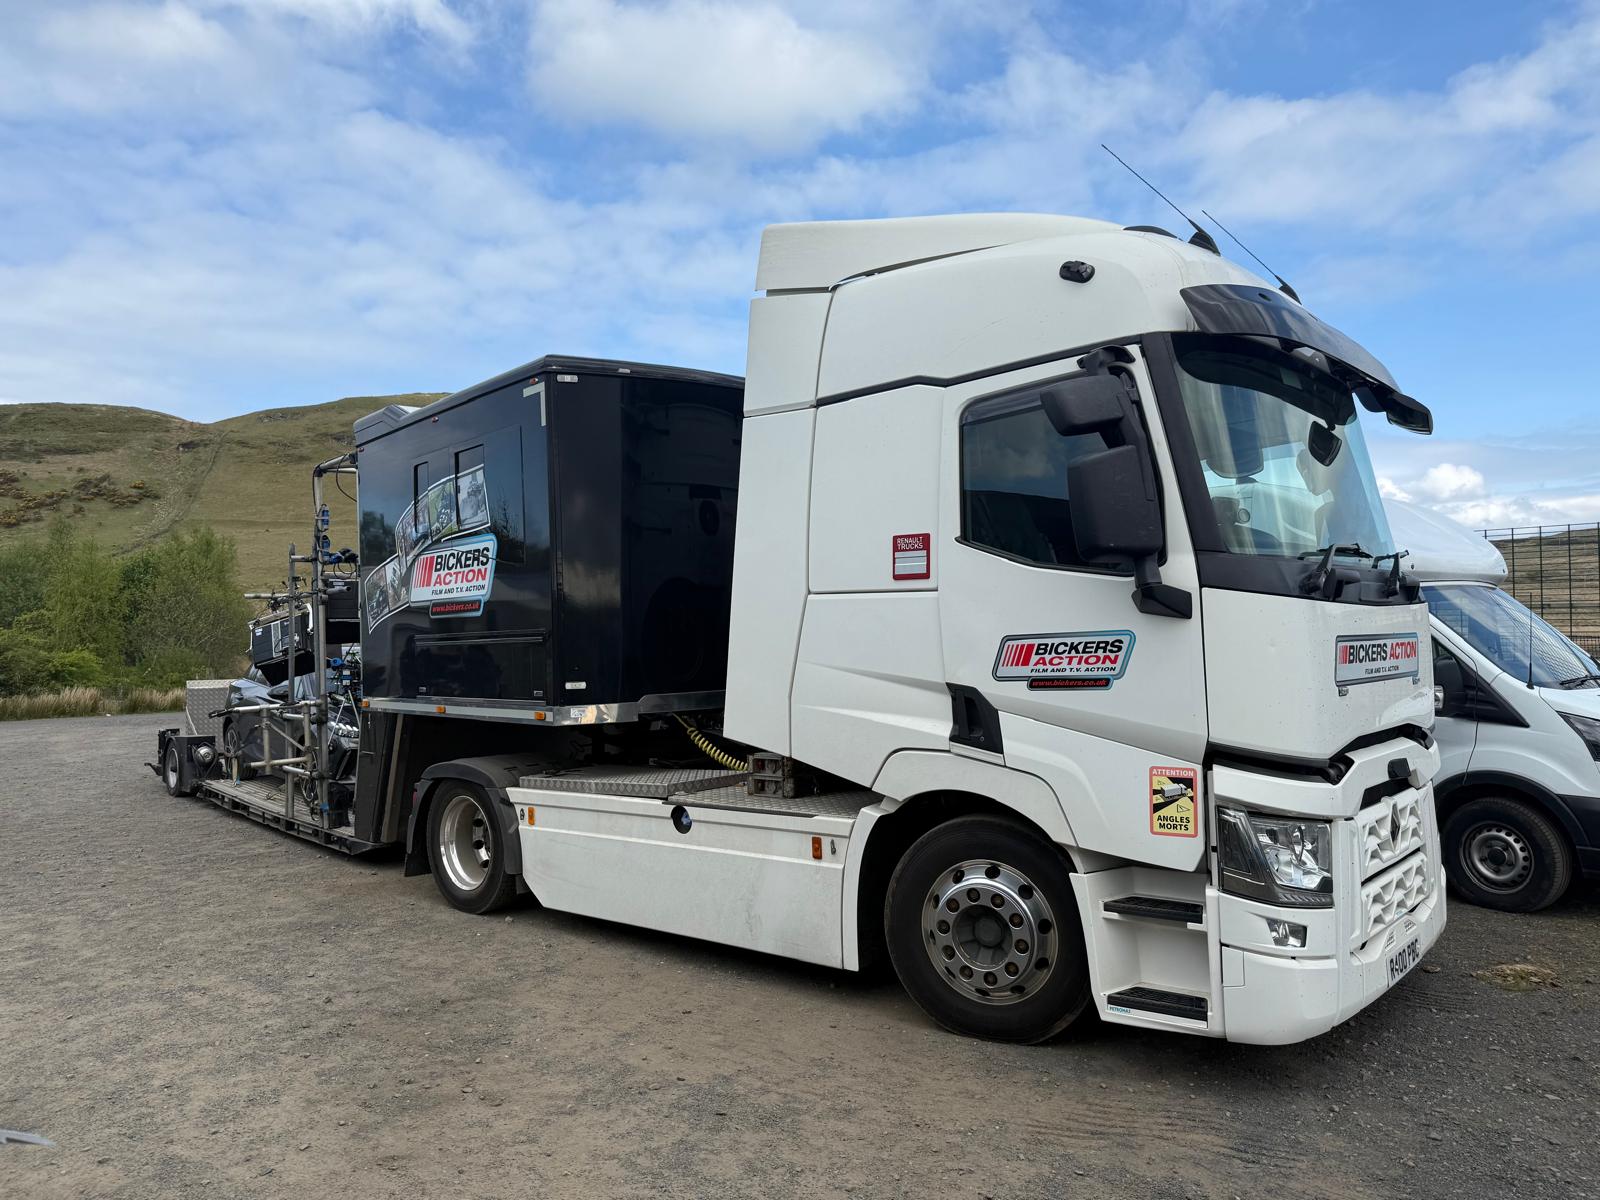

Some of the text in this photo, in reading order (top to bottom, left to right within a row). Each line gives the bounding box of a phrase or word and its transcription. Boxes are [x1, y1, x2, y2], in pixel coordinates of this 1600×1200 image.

[434, 547, 490, 572] BICKERS
[433, 568, 488, 587] ACTION
[465, 584, 486, 592] ACTION
[432, 602, 480, 612] www.bickers.co.uk
[1034, 639, 1124, 656] BICKERS
[1348, 641, 1416, 664] BICKERS ACTION
[1033, 654, 1120, 667] ACTION
[1032, 679, 1107, 687] www.bickers.co.uk
[1152, 768, 1194, 777] ATTENTION
[1157, 815, 1190, 824] ANGLES
[1159, 822, 1189, 831] MORTS
